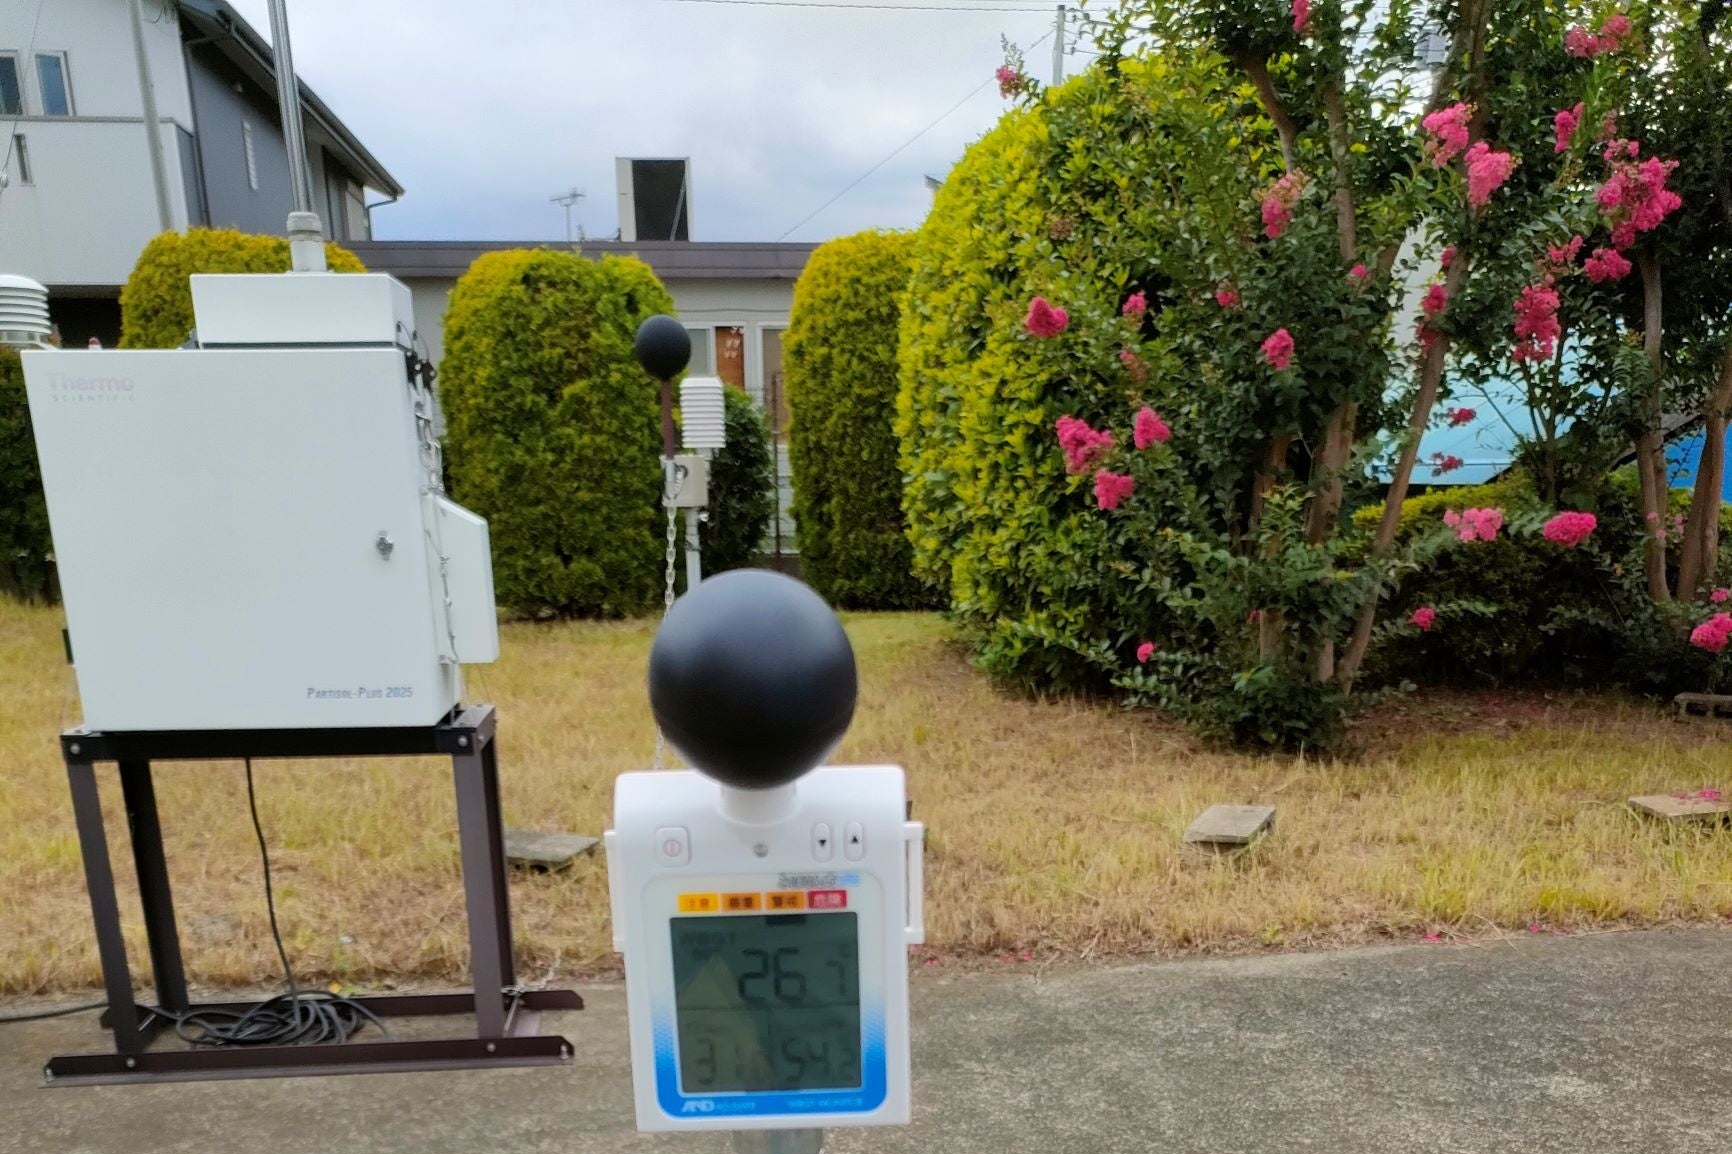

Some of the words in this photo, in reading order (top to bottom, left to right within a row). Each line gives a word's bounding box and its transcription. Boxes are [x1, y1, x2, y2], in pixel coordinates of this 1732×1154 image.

[47, 372, 135, 391] Thermo
[51, 393, 135, 402] SCIENTIFIC
[385, 686, 414, 698] 2025
